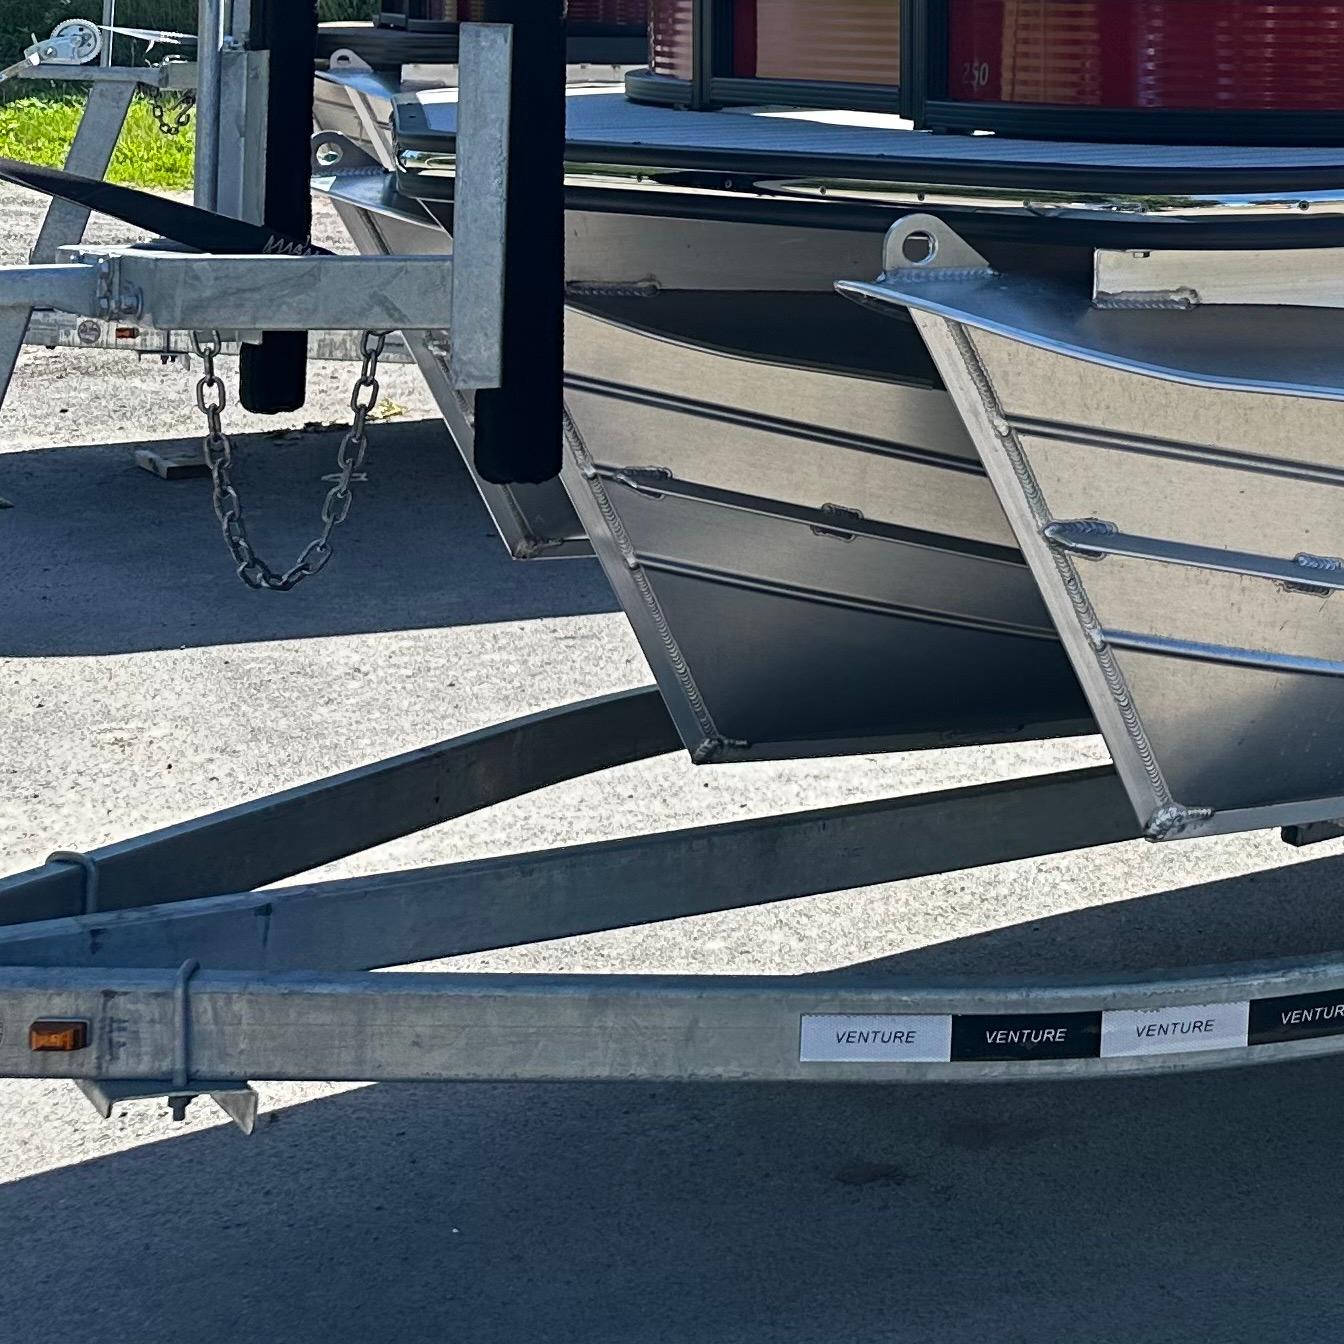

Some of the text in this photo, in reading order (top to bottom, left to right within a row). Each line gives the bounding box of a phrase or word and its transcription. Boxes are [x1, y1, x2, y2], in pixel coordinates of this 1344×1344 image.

[985, 1028, 1068, 1044] VENTURE
[1136, 1019, 1217, 1038] VENTURE
[835, 1030, 917, 1044] VENTURE
